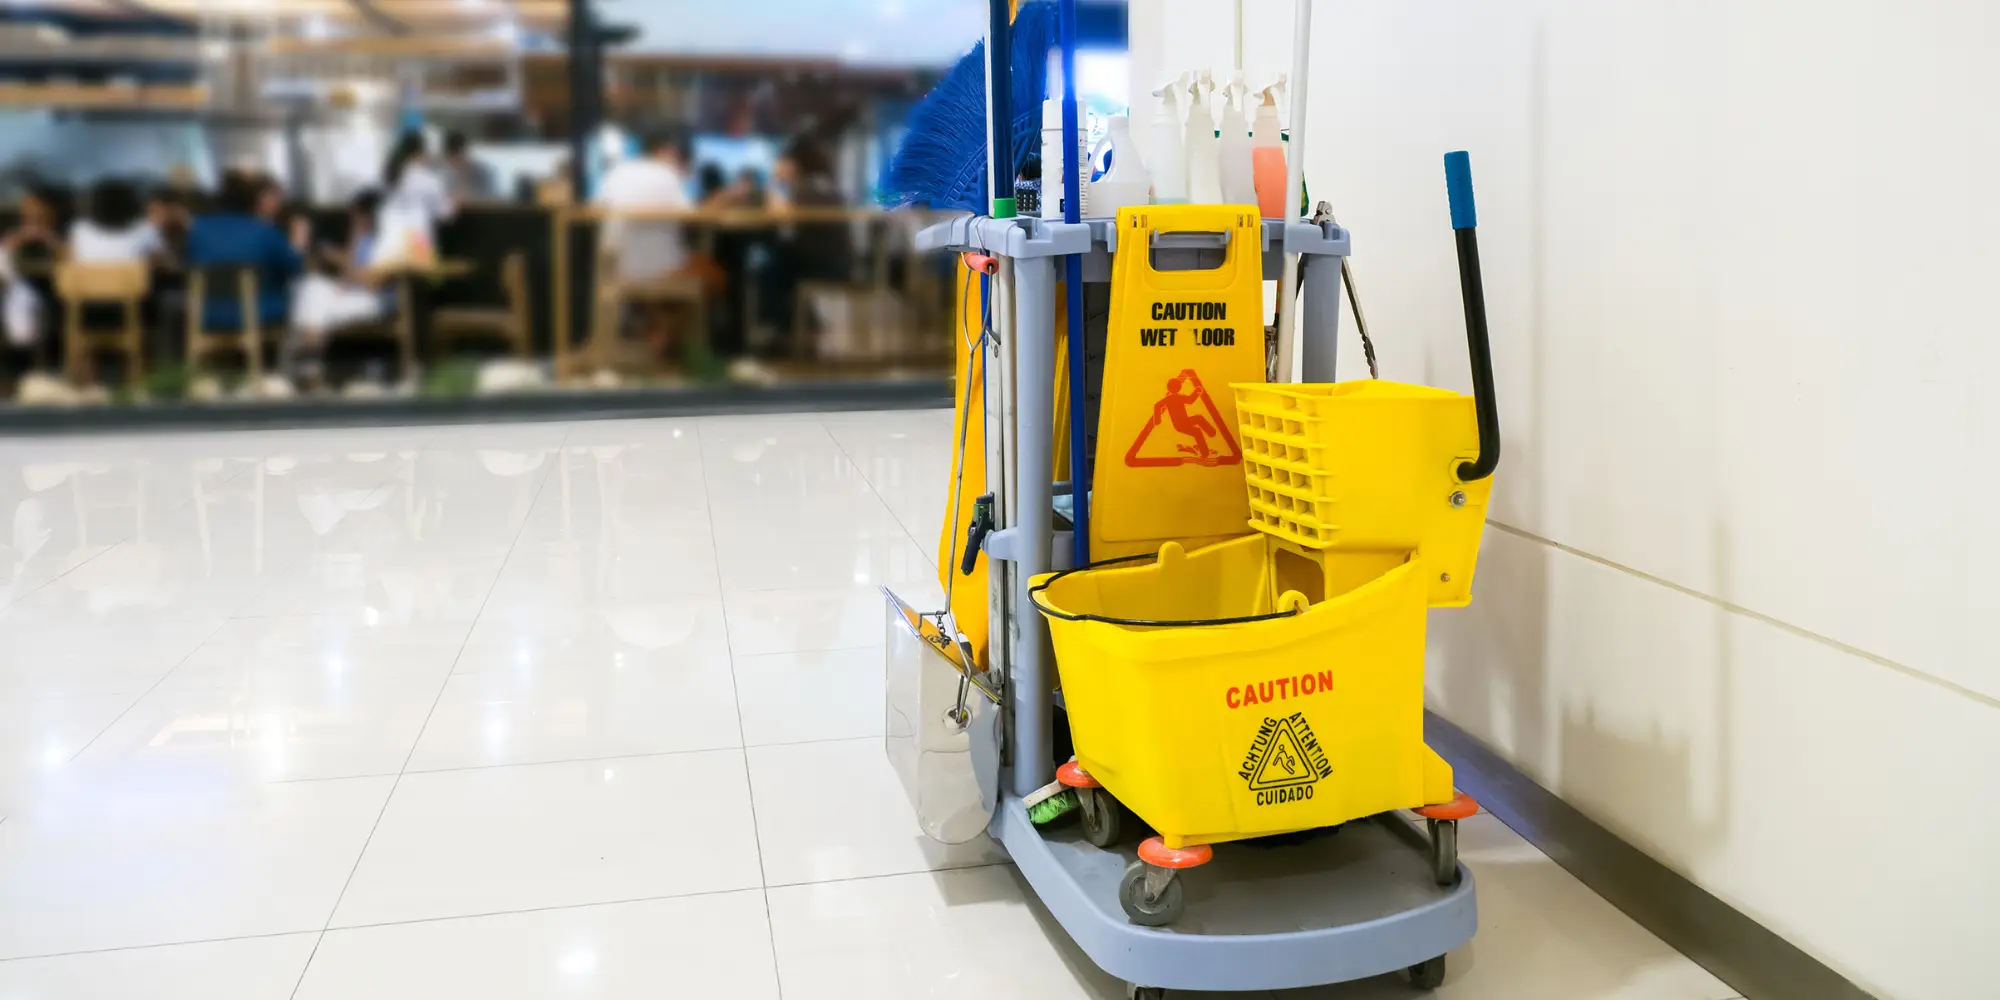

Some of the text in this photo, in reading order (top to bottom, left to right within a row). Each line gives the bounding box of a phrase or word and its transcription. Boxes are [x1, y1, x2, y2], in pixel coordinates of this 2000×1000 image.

[1152, 302, 1226, 321] CAUTION
[1140, 328, 1235, 346] WET LOOR
[1226, 670, 1333, 709] CAUTION
[1238, 717, 1277, 781] ACHTUNG
[1289, 712, 1333, 779] ATTENTION
[1257, 785, 1313, 806] CUIDADO
